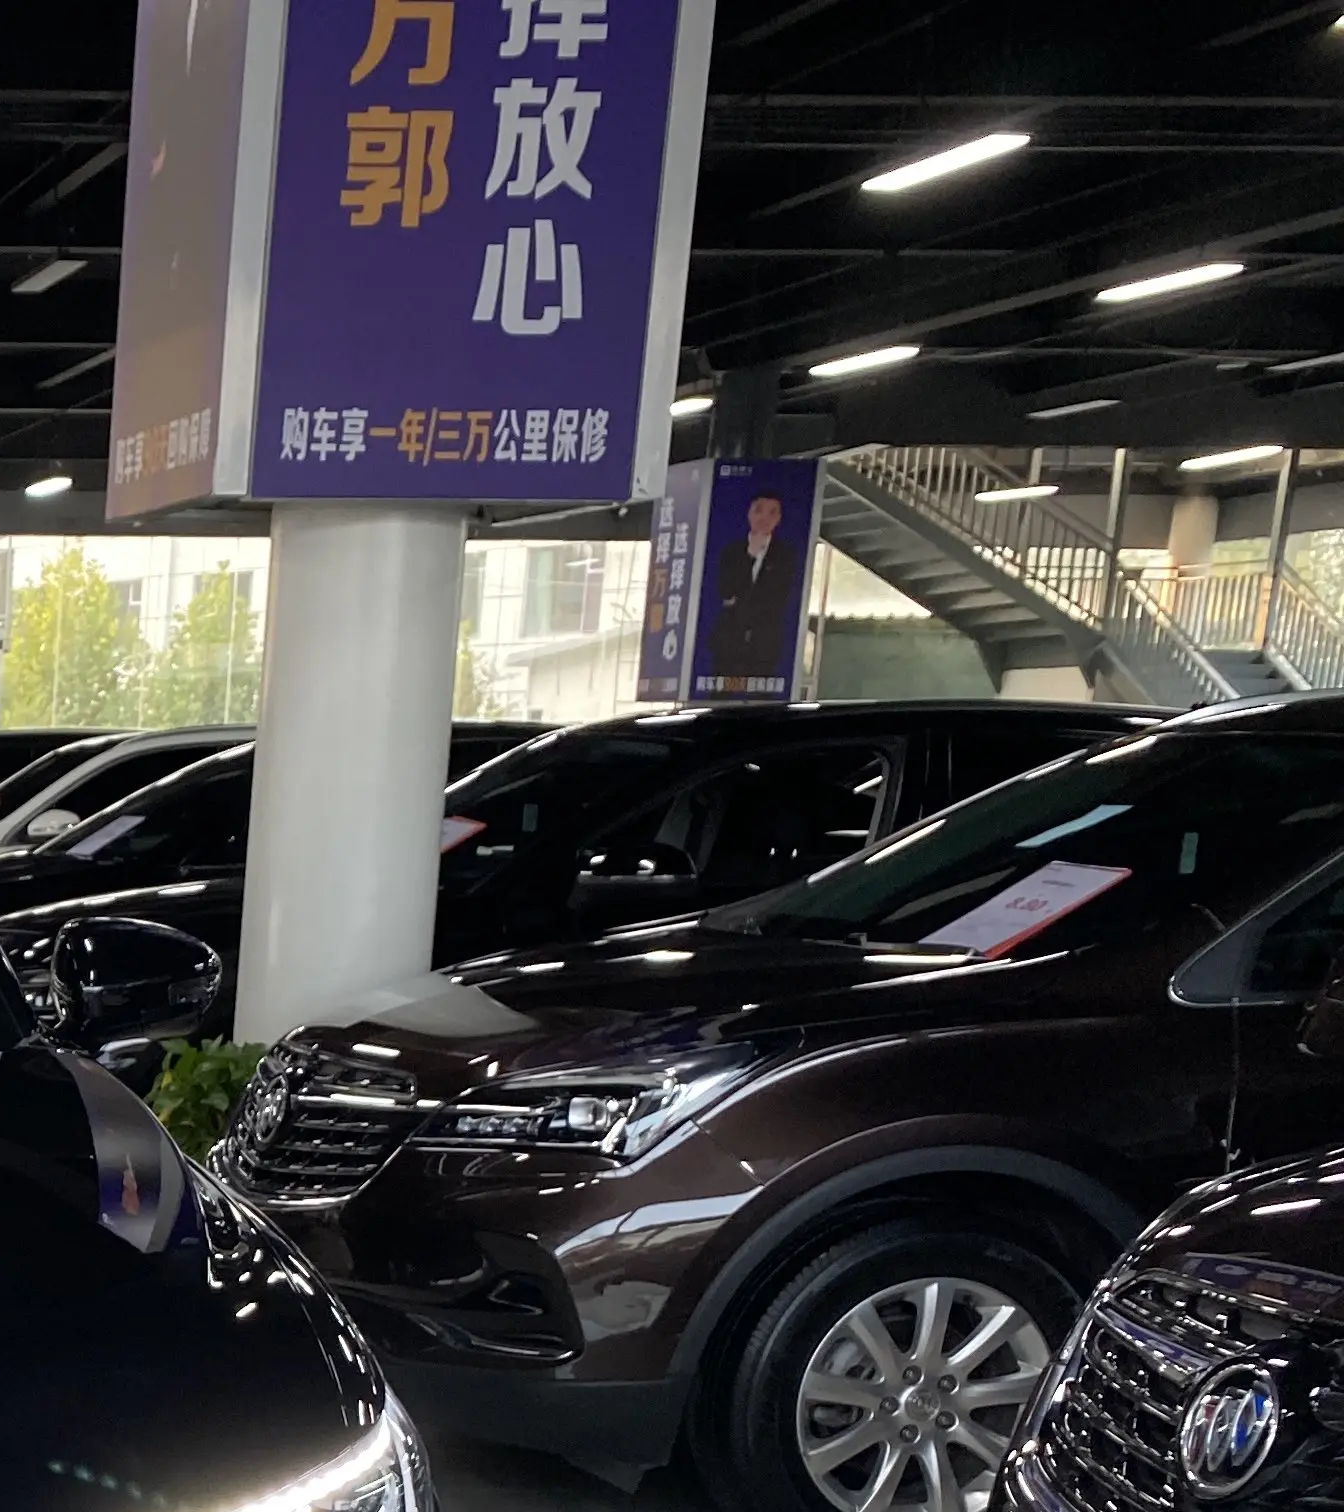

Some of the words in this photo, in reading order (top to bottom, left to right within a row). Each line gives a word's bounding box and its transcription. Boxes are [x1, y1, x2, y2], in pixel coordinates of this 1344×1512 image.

[339, 0, 455, 228] 万郭
[280, 406, 610, 467] 购车享一年/三万公里保修
